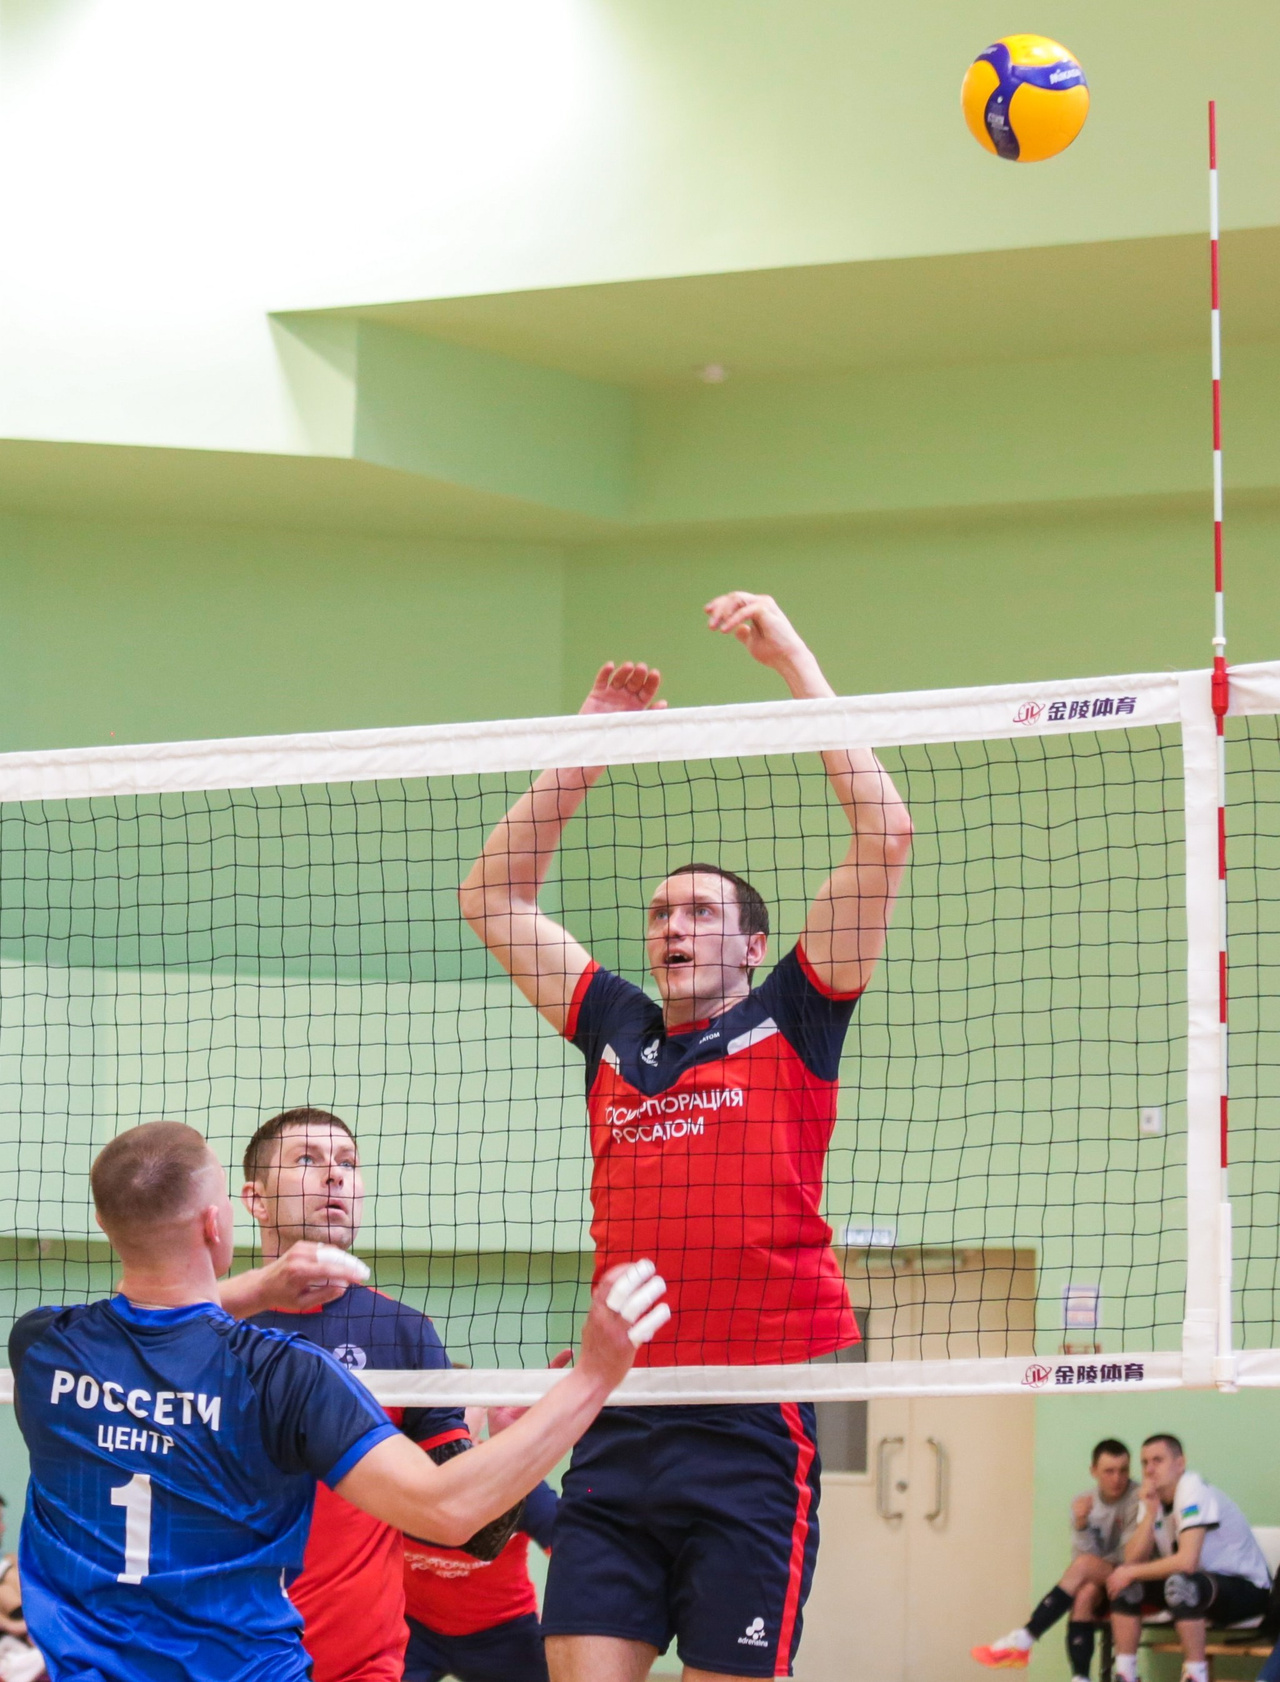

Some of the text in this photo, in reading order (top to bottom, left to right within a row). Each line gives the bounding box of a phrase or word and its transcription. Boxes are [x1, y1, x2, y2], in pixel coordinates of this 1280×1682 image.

[1047, 696, 1137, 722] 金陵体育
[611, 1116, 705, 1144] РОСАТОМ
[1054, 1363, 1144, 1385] 金陵体育
[50, 1369, 221, 1432] РОССЕТИ
[98, 1424, 175, 1455] ЦЕНТР
[110, 1473, 152, 1585] 1
